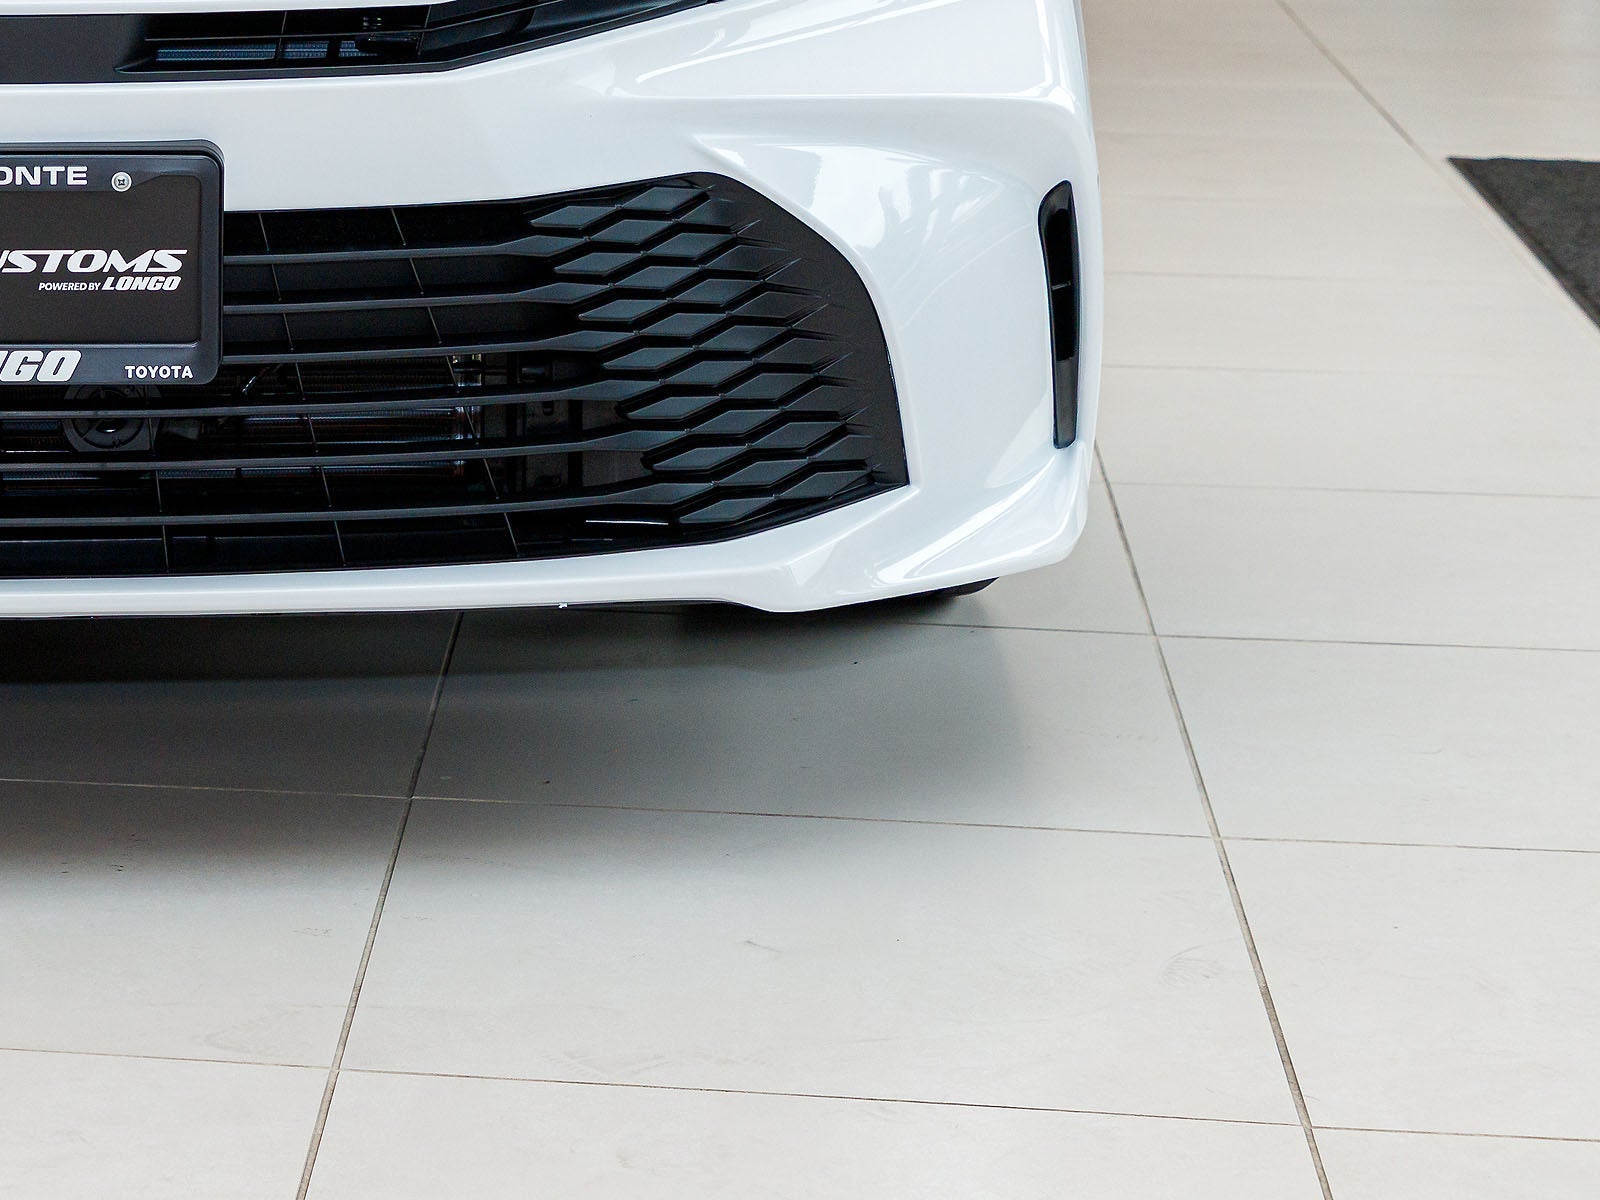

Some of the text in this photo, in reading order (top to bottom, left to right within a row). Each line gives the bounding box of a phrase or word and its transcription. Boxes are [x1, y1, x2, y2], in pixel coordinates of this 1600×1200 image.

[38, 275, 182, 291] POWERED BY LONGO
[124, 365, 194, 380] TOYOTA
